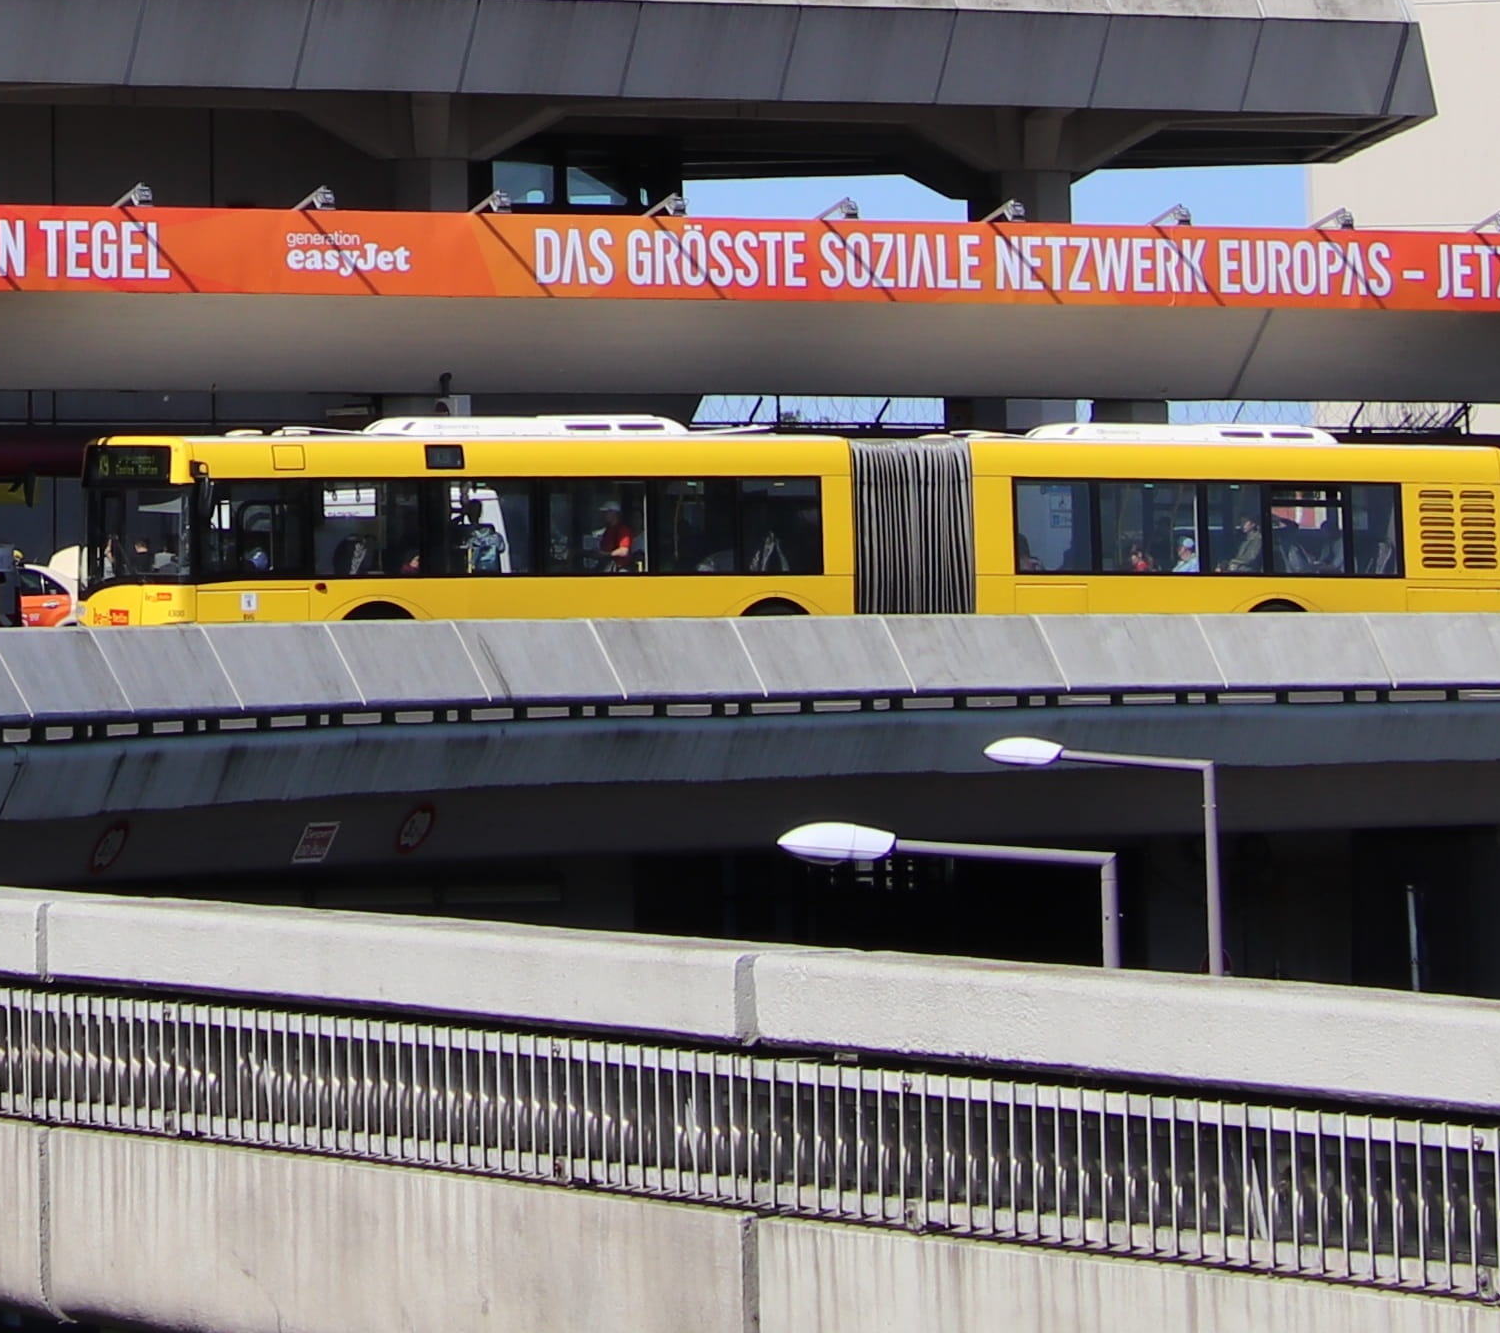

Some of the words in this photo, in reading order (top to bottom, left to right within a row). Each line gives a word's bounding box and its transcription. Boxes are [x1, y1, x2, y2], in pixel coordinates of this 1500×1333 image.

[38, 219, 171, 281] TEGEL
[286, 231, 361, 248] generation
[286, 242, 411, 276] easyJet
[534, 227, 614, 286] DAS
[626, 224, 808, 288] GRÖSSTE
[820, 232, 982, 290] SOZIALE
[994, 234, 1208, 294] NETZWERK
[1218, 239, 1393, 297] EUROPAS
